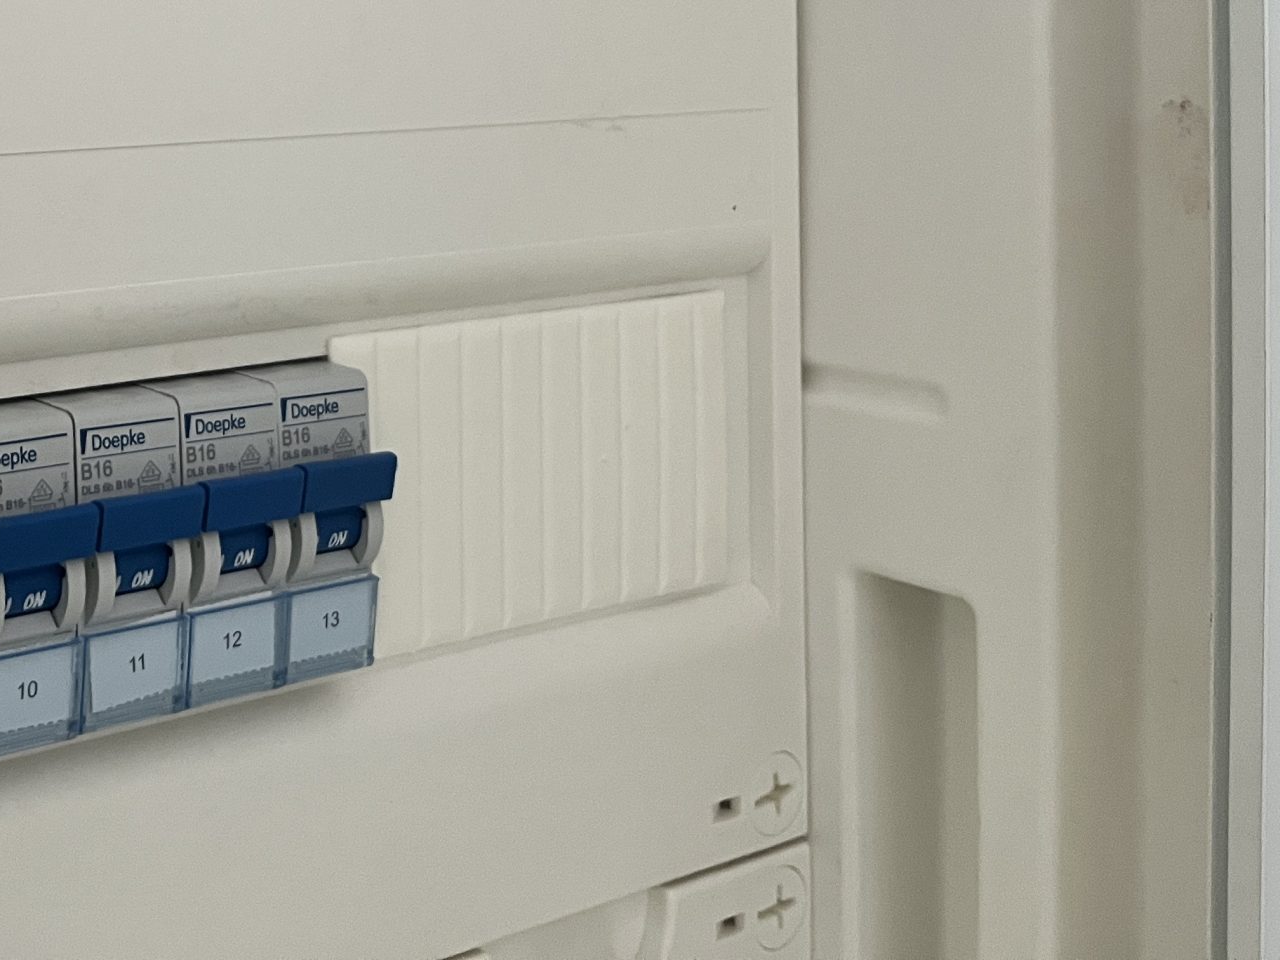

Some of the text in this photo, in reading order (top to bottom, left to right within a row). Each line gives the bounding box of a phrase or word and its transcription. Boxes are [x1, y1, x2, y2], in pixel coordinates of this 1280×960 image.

[291, 398, 340, 420] Doepke
[195, 414, 246, 436] Doepke
[91, 428, 146, 452] Doepke
[282, 426, 310, 446] B16
[186, 443, 216, 463] B16
[81, 460, 113, 480] B16
[328, 530, 348, 548] ON
[234, 548, 255, 567] ON
[131, 568, 155, 588] ON
[23, 590, 46, 610] ON
[322, 610, 340, 629] 13
[223, 630, 242, 650] 12
[129, 653, 146, 673] 11
[18, 680, 38, 700] 10
